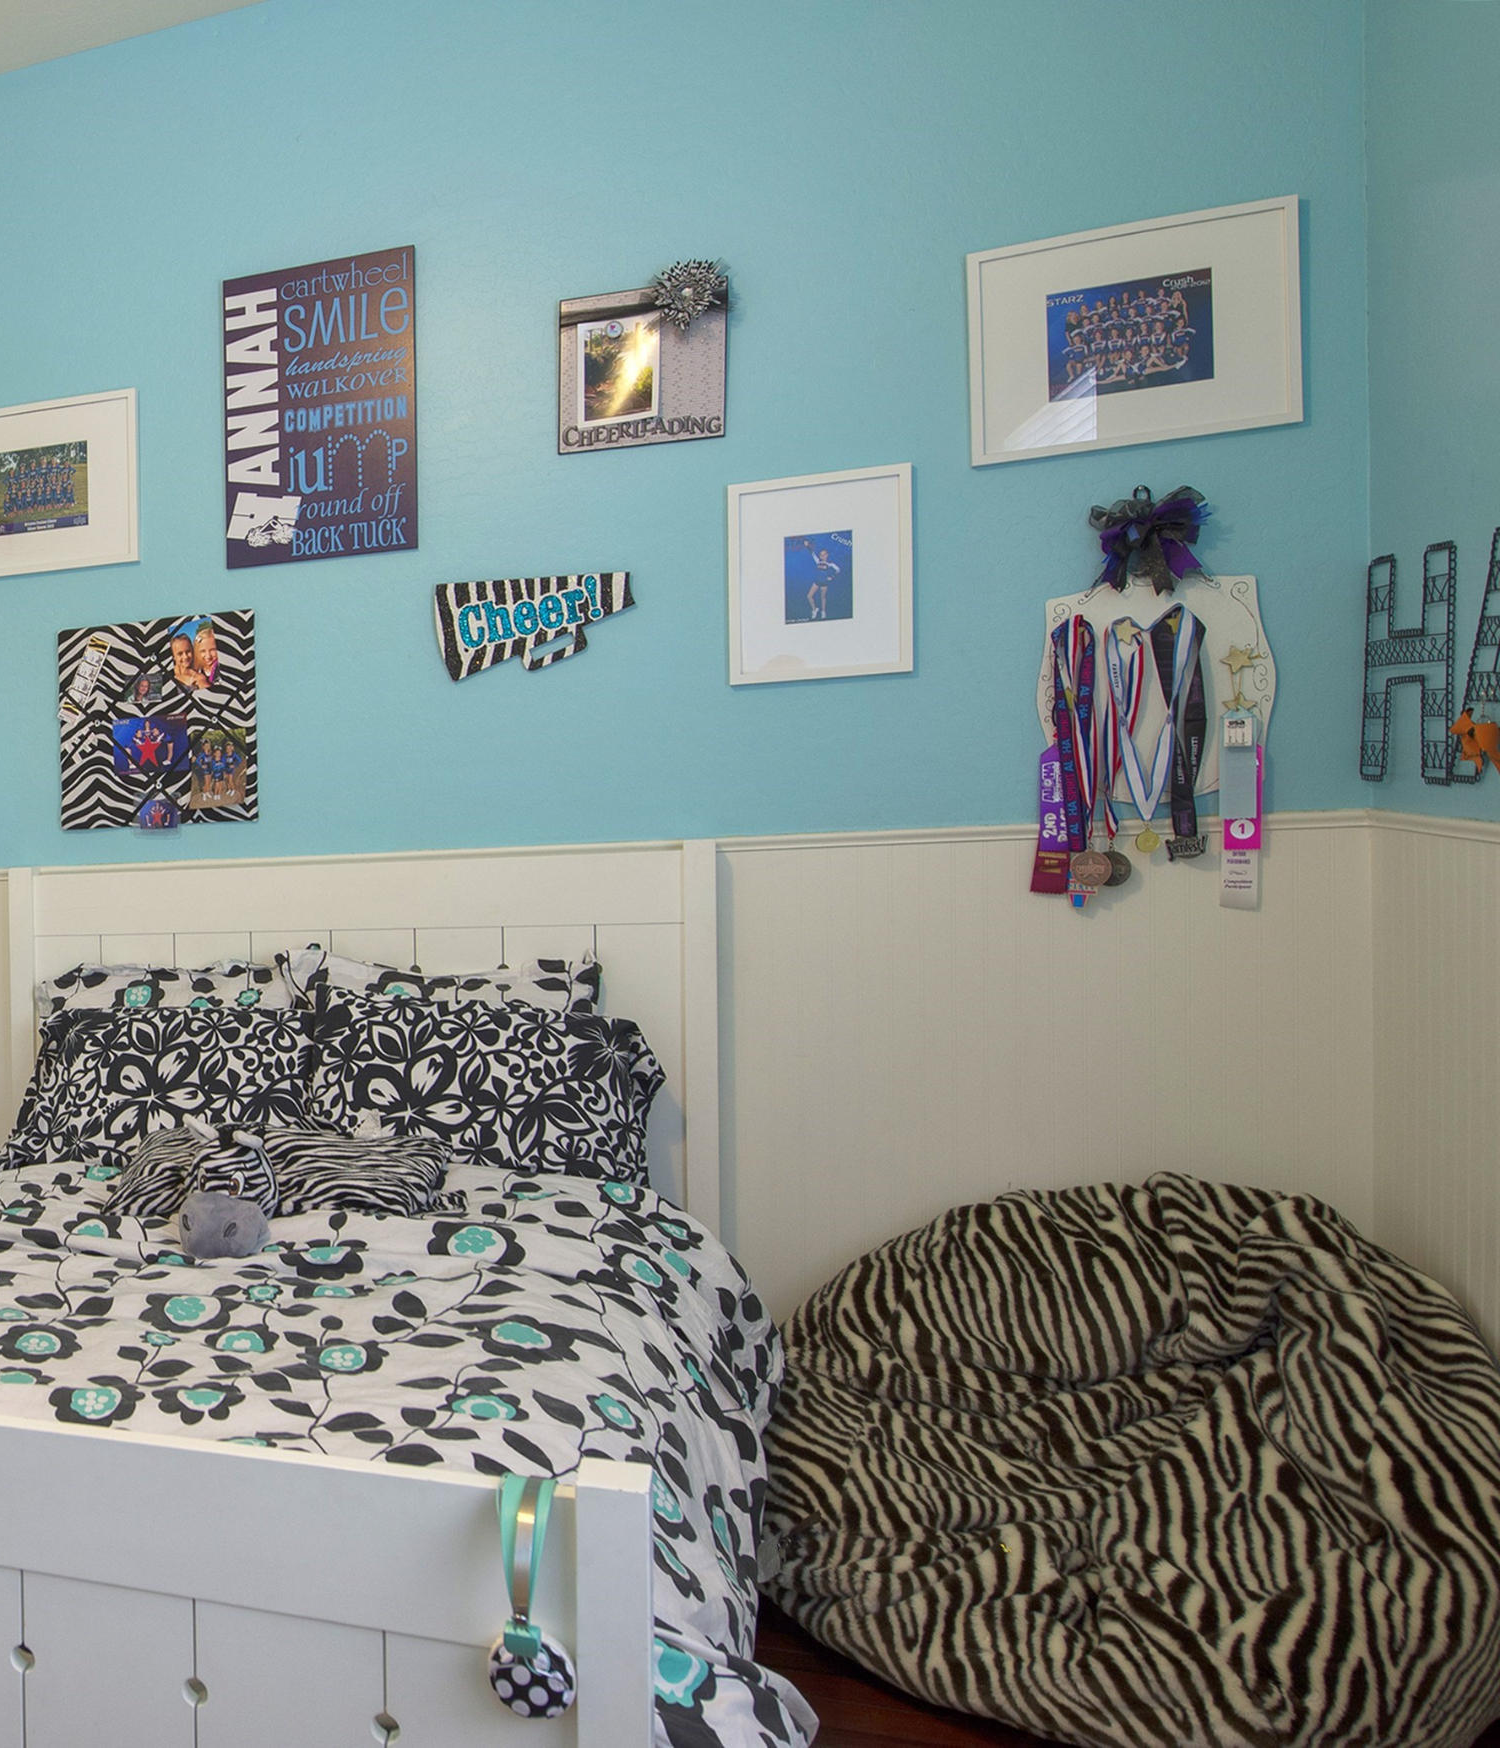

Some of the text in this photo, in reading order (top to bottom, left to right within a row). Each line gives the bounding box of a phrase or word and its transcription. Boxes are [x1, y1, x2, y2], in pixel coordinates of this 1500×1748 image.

[280, 252, 408, 301] cartwheel
[285, 346, 408, 377] handspring
[284, 395, 408, 433] COMPETITION
[563, 415, 722, 448] CHEERLEADING
[296, 482, 406, 520] round off
[458, 575, 602, 649] Cheer!
